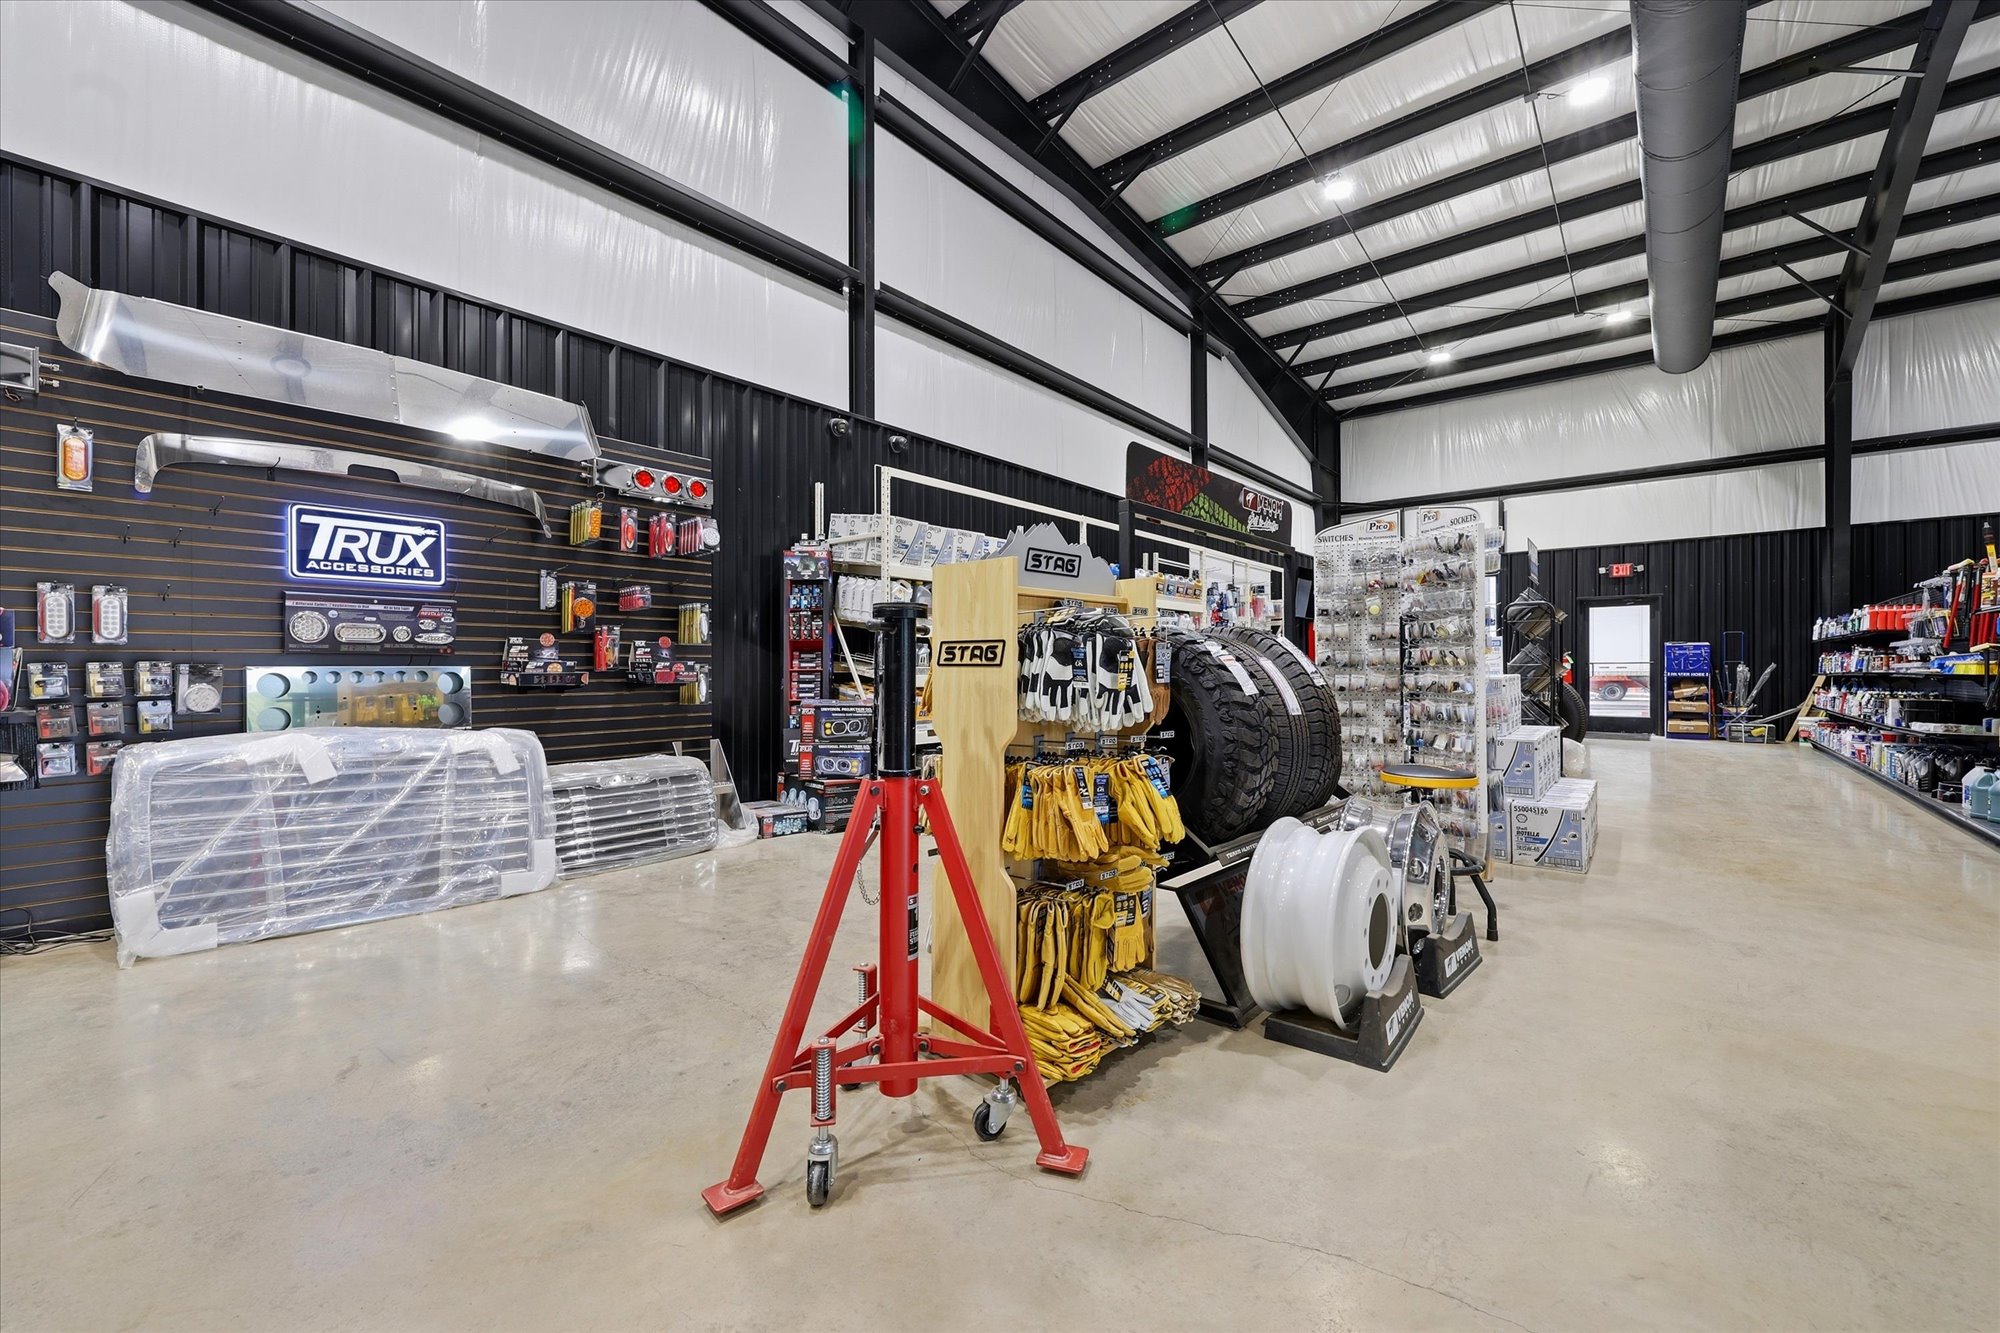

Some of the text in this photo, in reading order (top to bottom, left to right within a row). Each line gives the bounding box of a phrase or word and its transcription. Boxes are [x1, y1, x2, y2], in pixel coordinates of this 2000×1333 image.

[1423, 511, 1437, 523] Pico
[1450, 512, 1478, 527] SOCKETS
[1368, 521, 1389, 532] Pico
[300, 514, 440, 568] TRUX
[1317, 534, 1354, 544] SWITCHES
[305, 559, 435, 578] ACCESSORIES
[1030, 553, 1077, 573] STAG
[1612, 564, 1631, 576] EXIT
[943, 645, 999, 662] STAG
[1513, 805, 1549, 815] 550045126
[1516, 830, 1540, 838] ROTELLA
